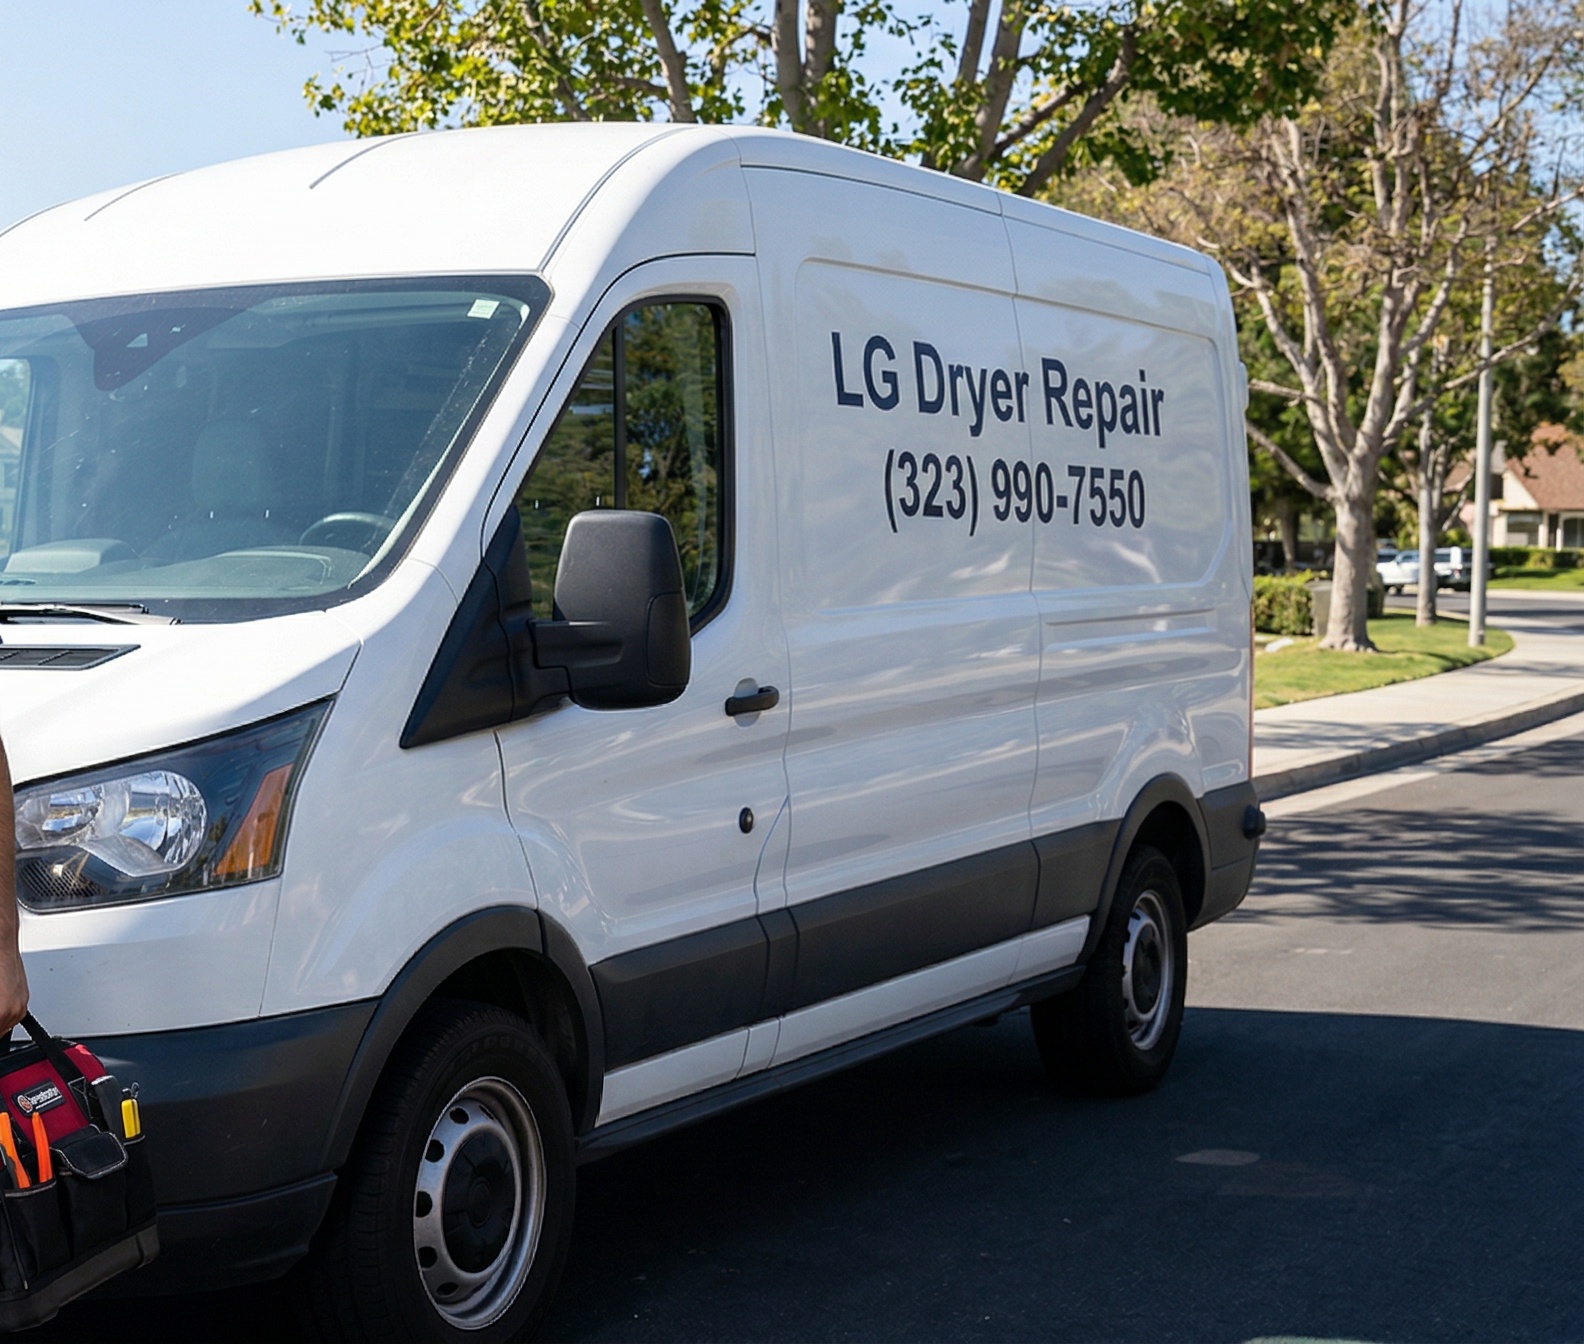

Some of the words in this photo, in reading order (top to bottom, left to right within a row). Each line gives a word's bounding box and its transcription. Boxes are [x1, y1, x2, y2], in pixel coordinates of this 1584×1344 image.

[831, 331, 900, 411] LG
[913, 340, 1030, 438] Dryer
[1041, 357, 1165, 449] Repair
[884, 448, 979, 537] (323)
[991, 458, 1146, 529] 990-7550
